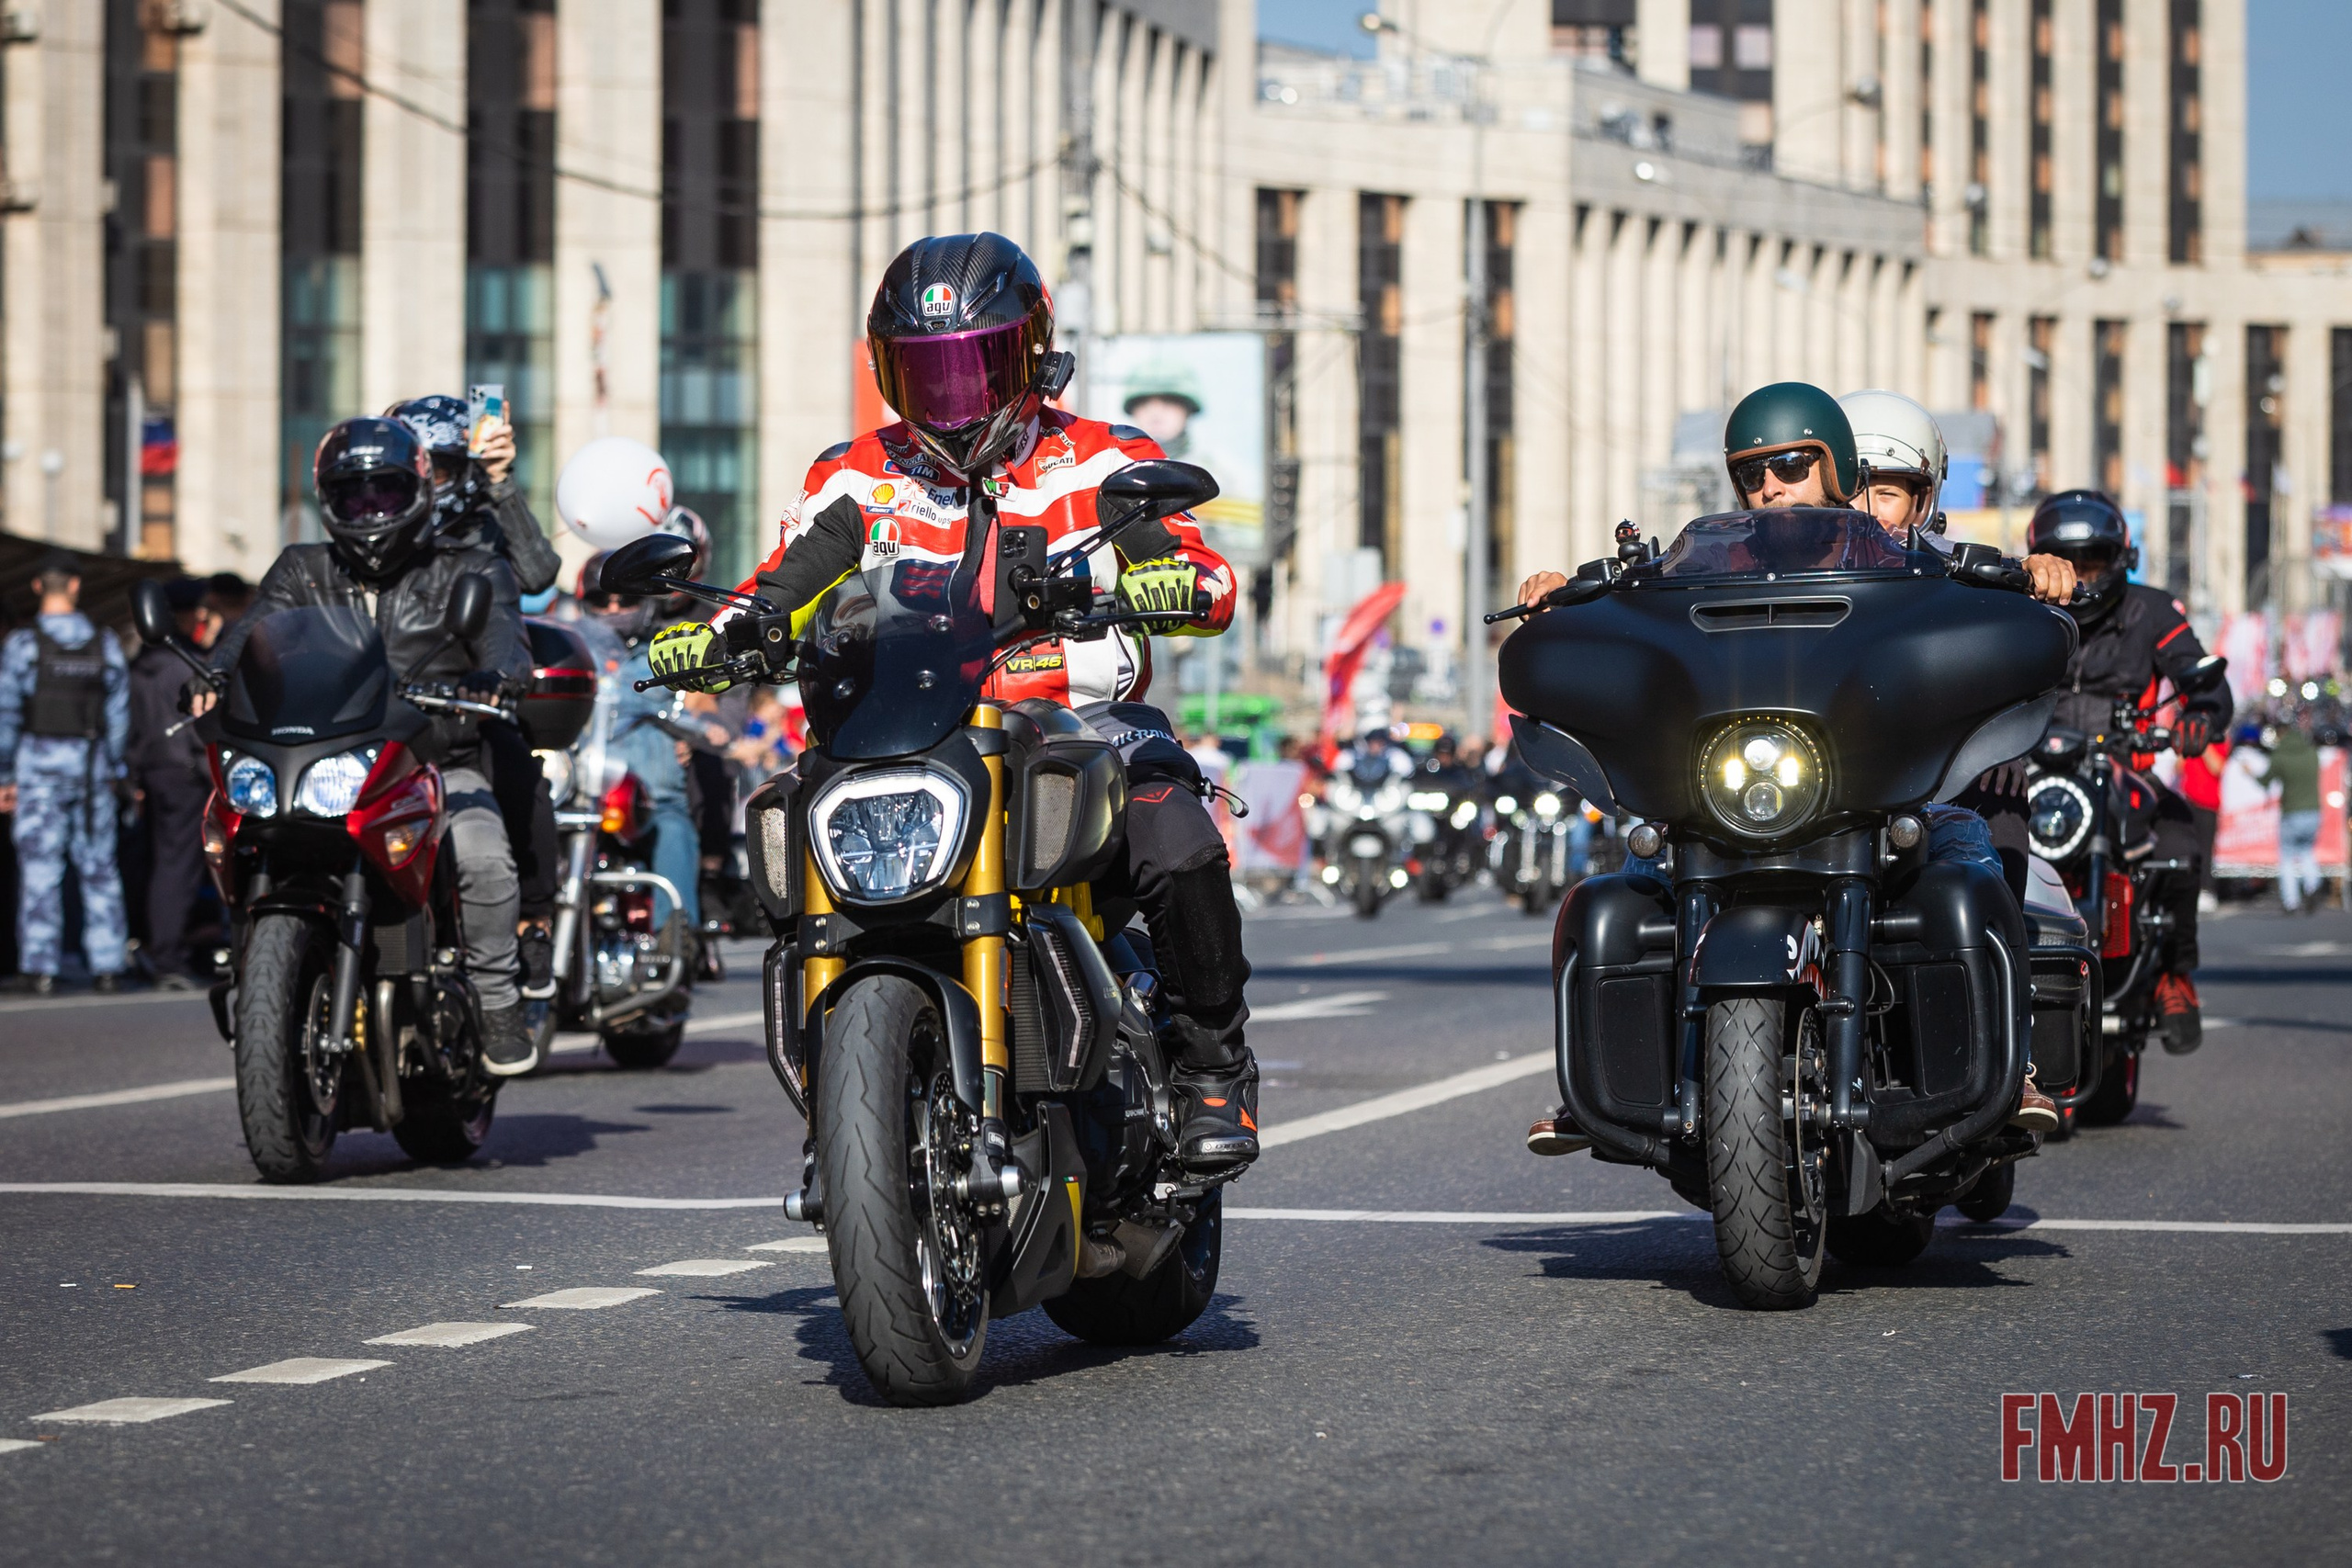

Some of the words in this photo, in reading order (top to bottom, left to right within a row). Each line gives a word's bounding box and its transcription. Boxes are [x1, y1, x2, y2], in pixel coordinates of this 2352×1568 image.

[926, 302, 950, 314] agv
[910, 466, 934, 478] TIM
[1041, 457, 1073, 472] DUCATI
[984, 479, 1010, 498] WLF
[927, 488, 956, 505] Enel
[911, 502, 936, 521] riello
[937, 517, 951, 526] ups
[873, 541, 896, 556] agv
[271, 726, 314, 735] HONDA
